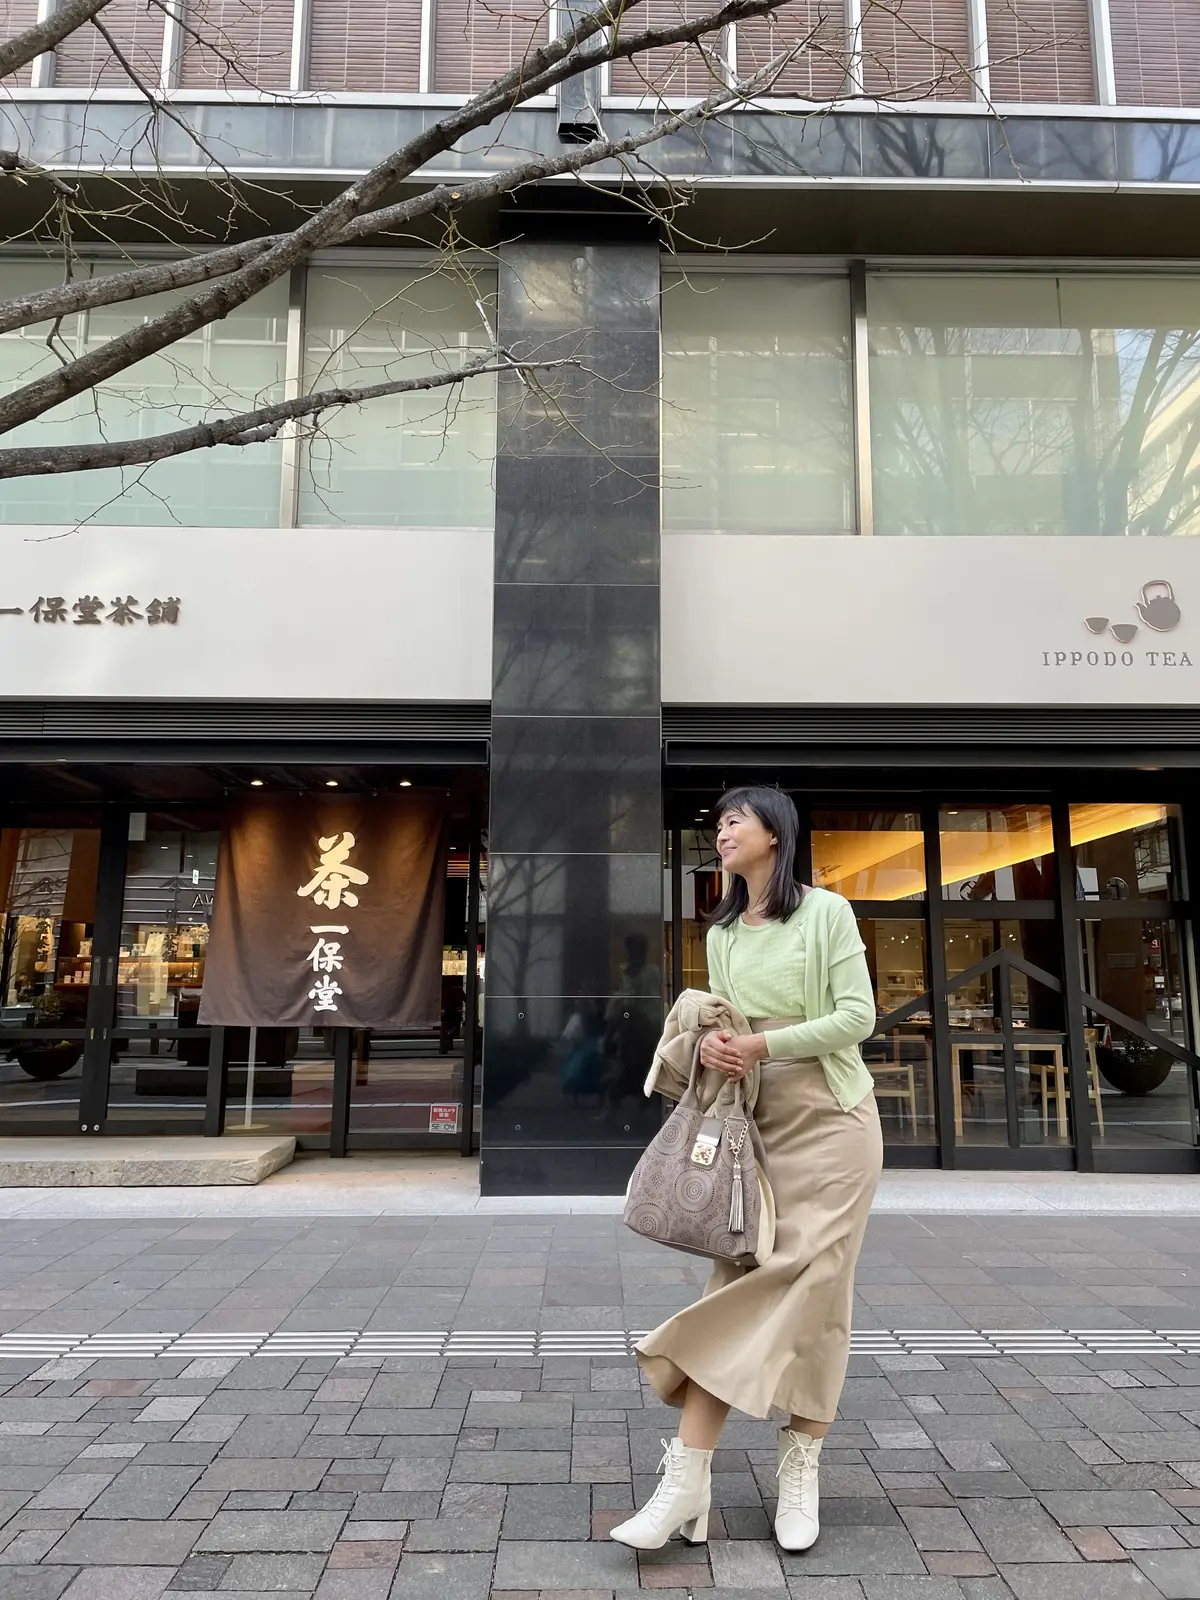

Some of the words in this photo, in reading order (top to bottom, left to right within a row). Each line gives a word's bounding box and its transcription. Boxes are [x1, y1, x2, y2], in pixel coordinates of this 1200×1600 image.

[1042, 651, 1134, 667] IPPODO
[1145, 651, 1194, 667] TEA
[297, 831, 369, 909] 茶
[306, 925, 349, 1012] 一保堂
